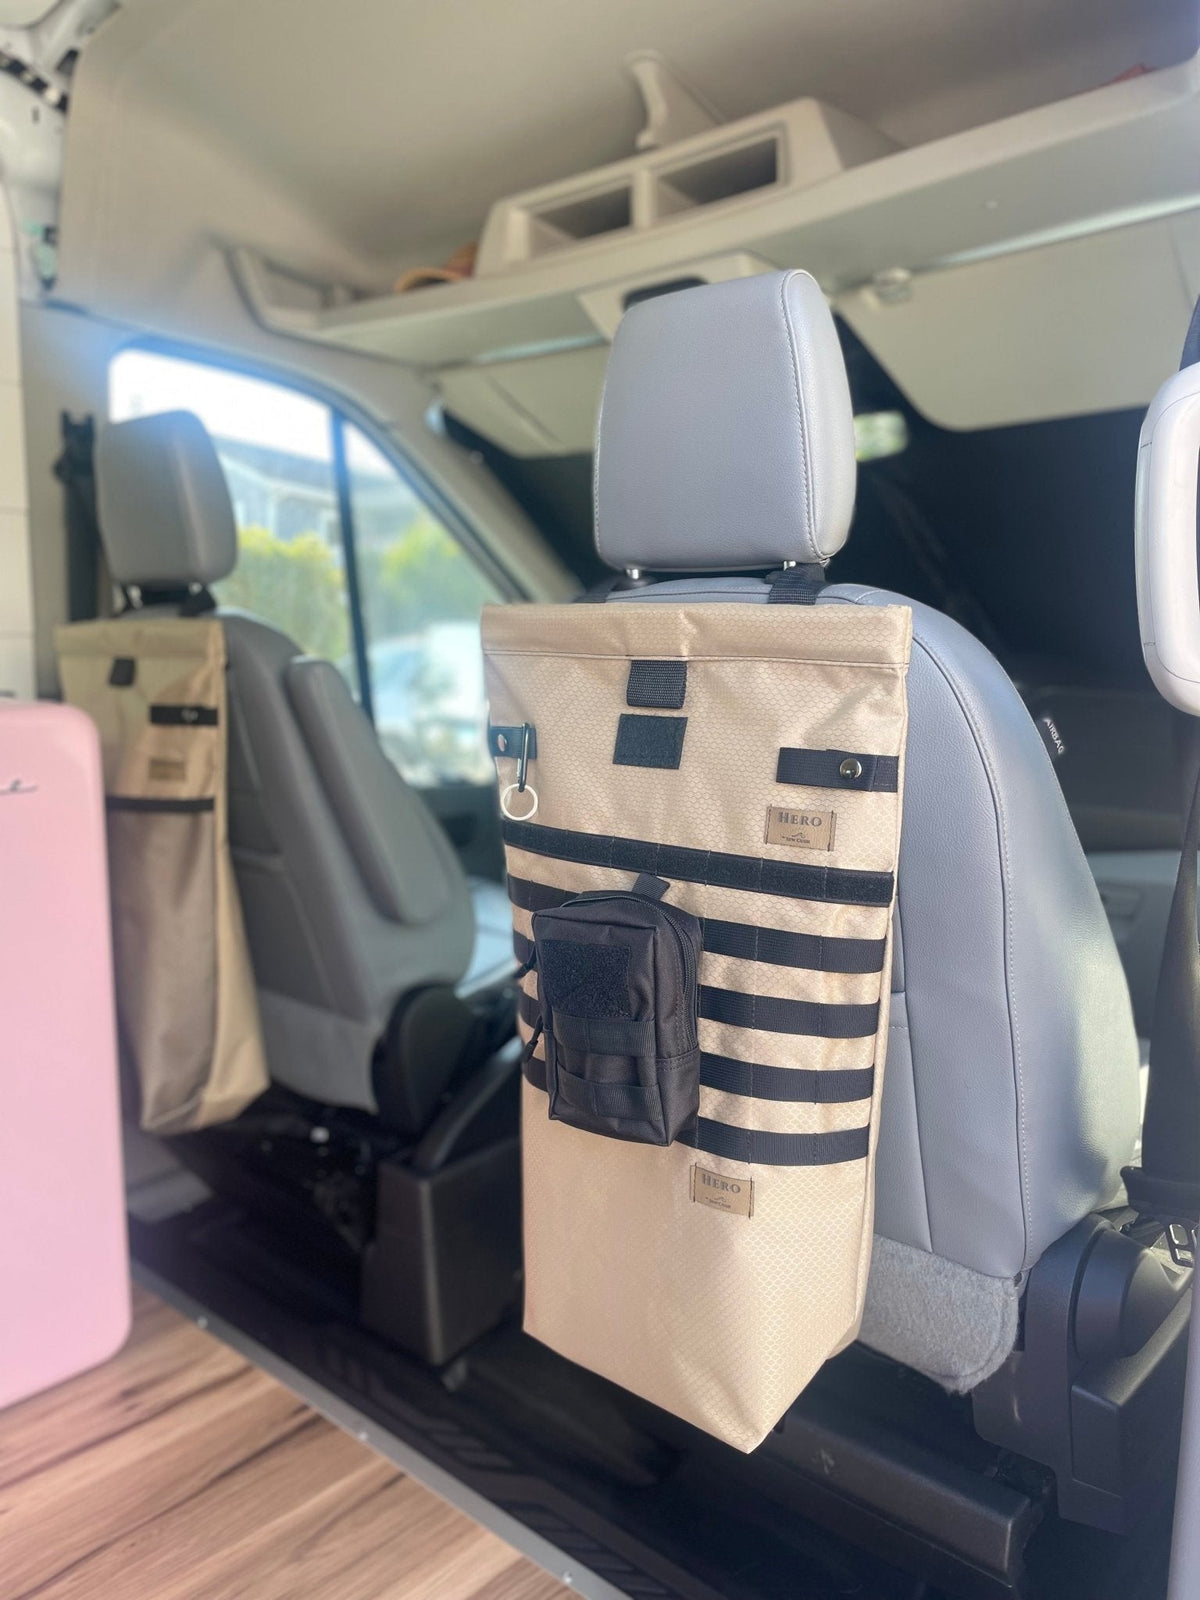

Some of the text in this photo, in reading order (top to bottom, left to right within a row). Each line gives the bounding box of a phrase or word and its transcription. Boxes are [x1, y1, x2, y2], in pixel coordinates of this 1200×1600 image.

[1043, 718, 1065, 754] AIRBAG
[778, 811, 822, 827] HERO
[702, 1173, 741, 1193] HERO
